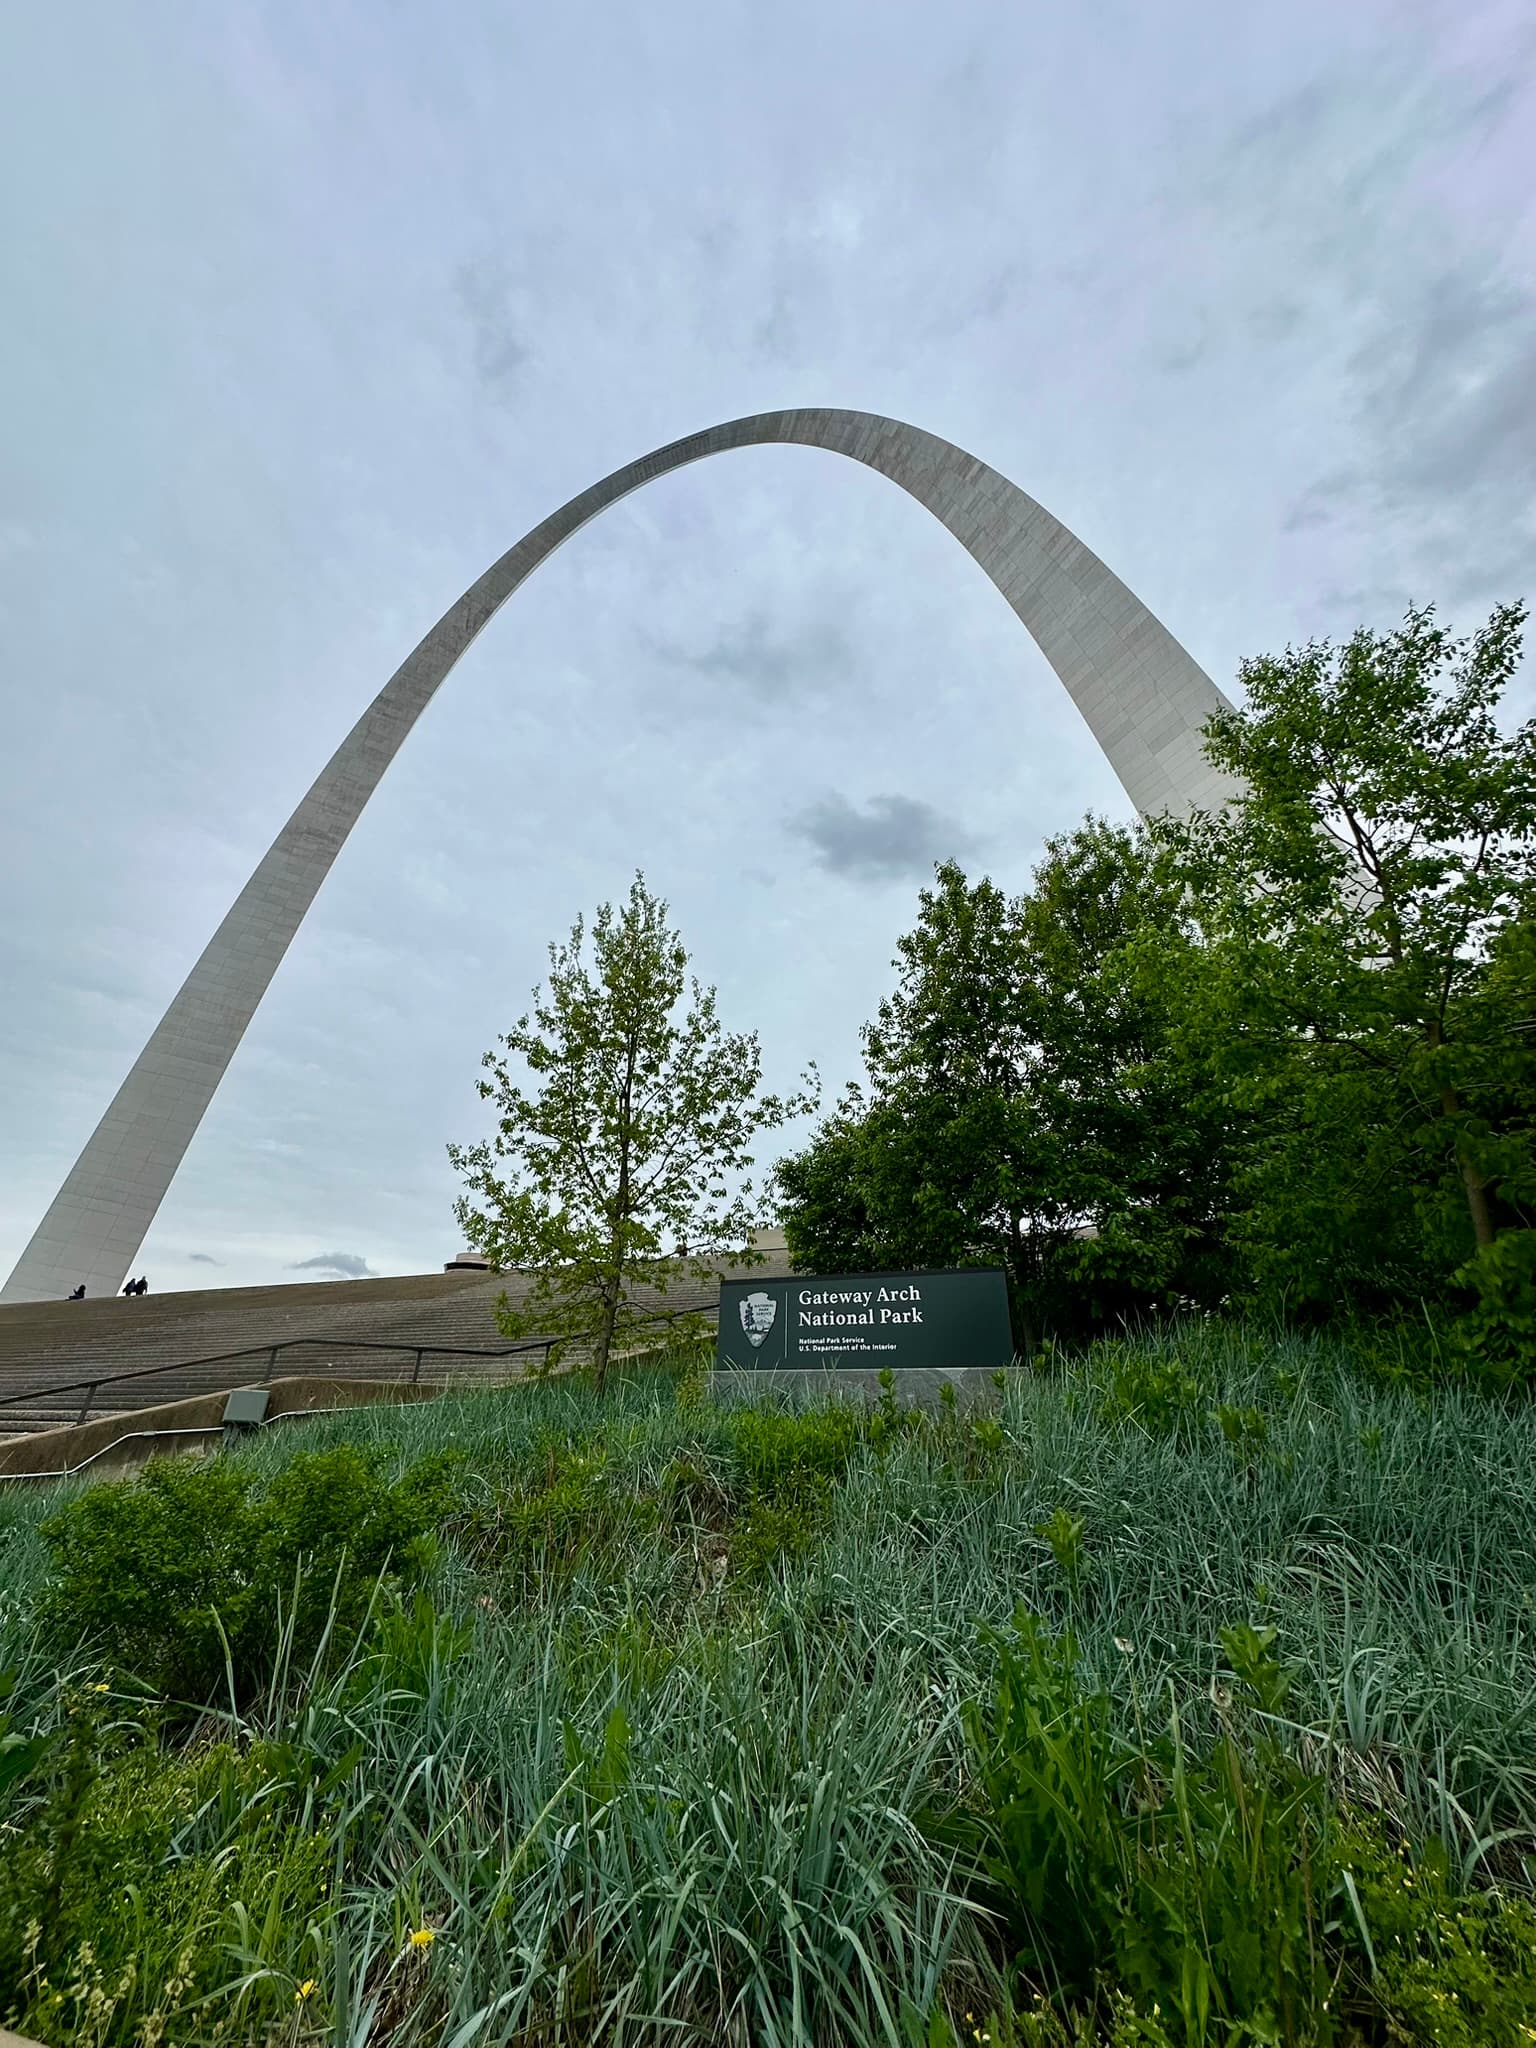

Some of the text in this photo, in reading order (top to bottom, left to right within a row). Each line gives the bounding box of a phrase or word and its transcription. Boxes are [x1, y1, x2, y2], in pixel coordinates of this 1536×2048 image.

[799, 1286, 922, 1307] Gateway Arch
[798, 1307, 923, 1327] National Park
[812, 1345, 850, 1353] Department
